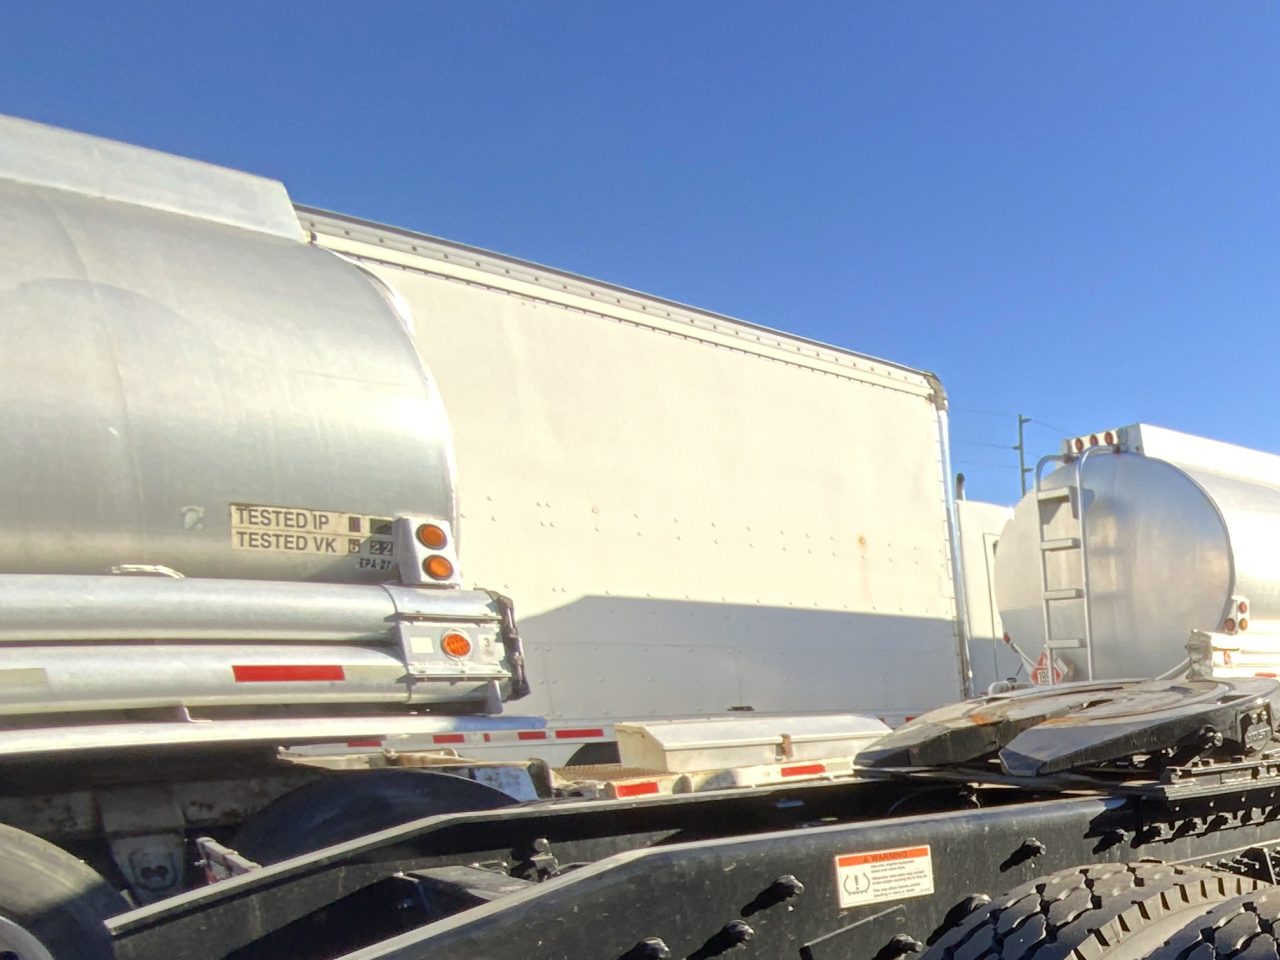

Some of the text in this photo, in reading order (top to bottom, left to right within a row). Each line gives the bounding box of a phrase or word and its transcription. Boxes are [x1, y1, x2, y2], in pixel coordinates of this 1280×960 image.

[236, 507, 329, 530] TESTED IP
[236, 531, 308, 551] TESTED
[313, 536, 337, 553] VK
[371, 541, 392, 555] 22
